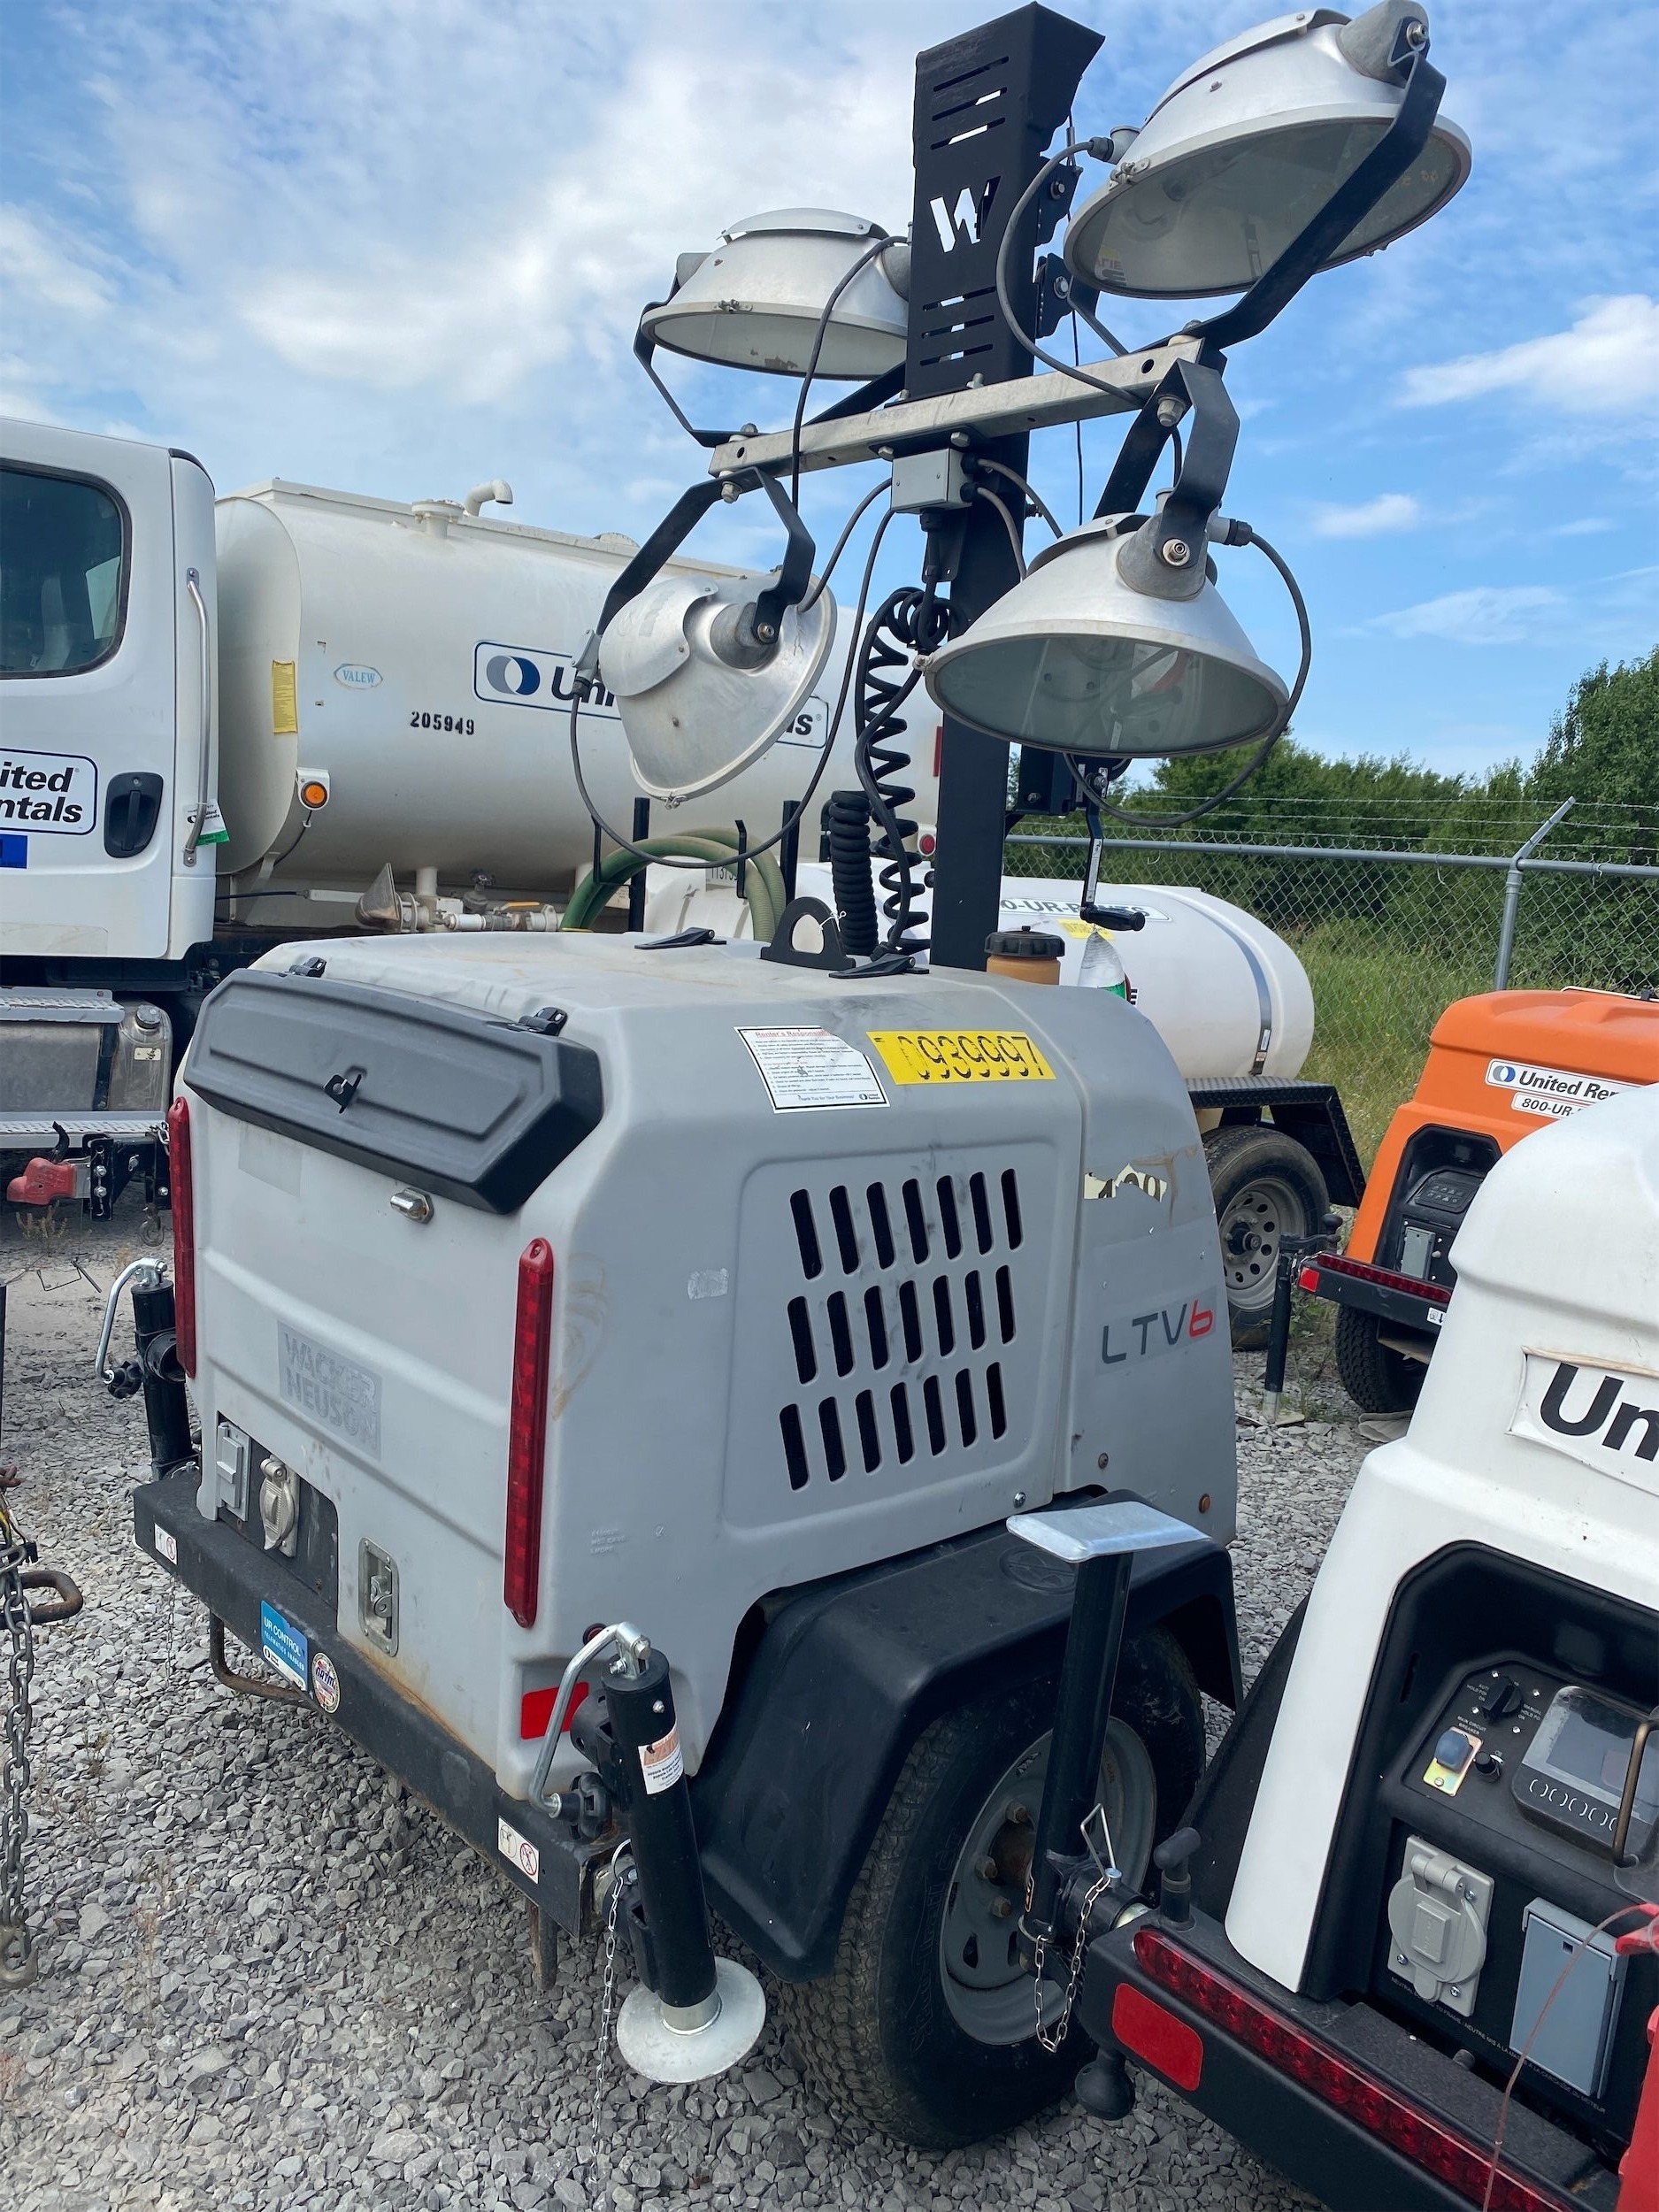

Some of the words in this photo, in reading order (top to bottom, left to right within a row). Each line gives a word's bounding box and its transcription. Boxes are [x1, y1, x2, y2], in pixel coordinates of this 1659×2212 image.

[342, 670, 375, 685] VALEW
[410, 710, 475, 735] 205949
[1519, 1071, 1582, 1095] United
[264, 1617, 273, 1631] UR
[273, 1625, 302, 1657] CONTROL
